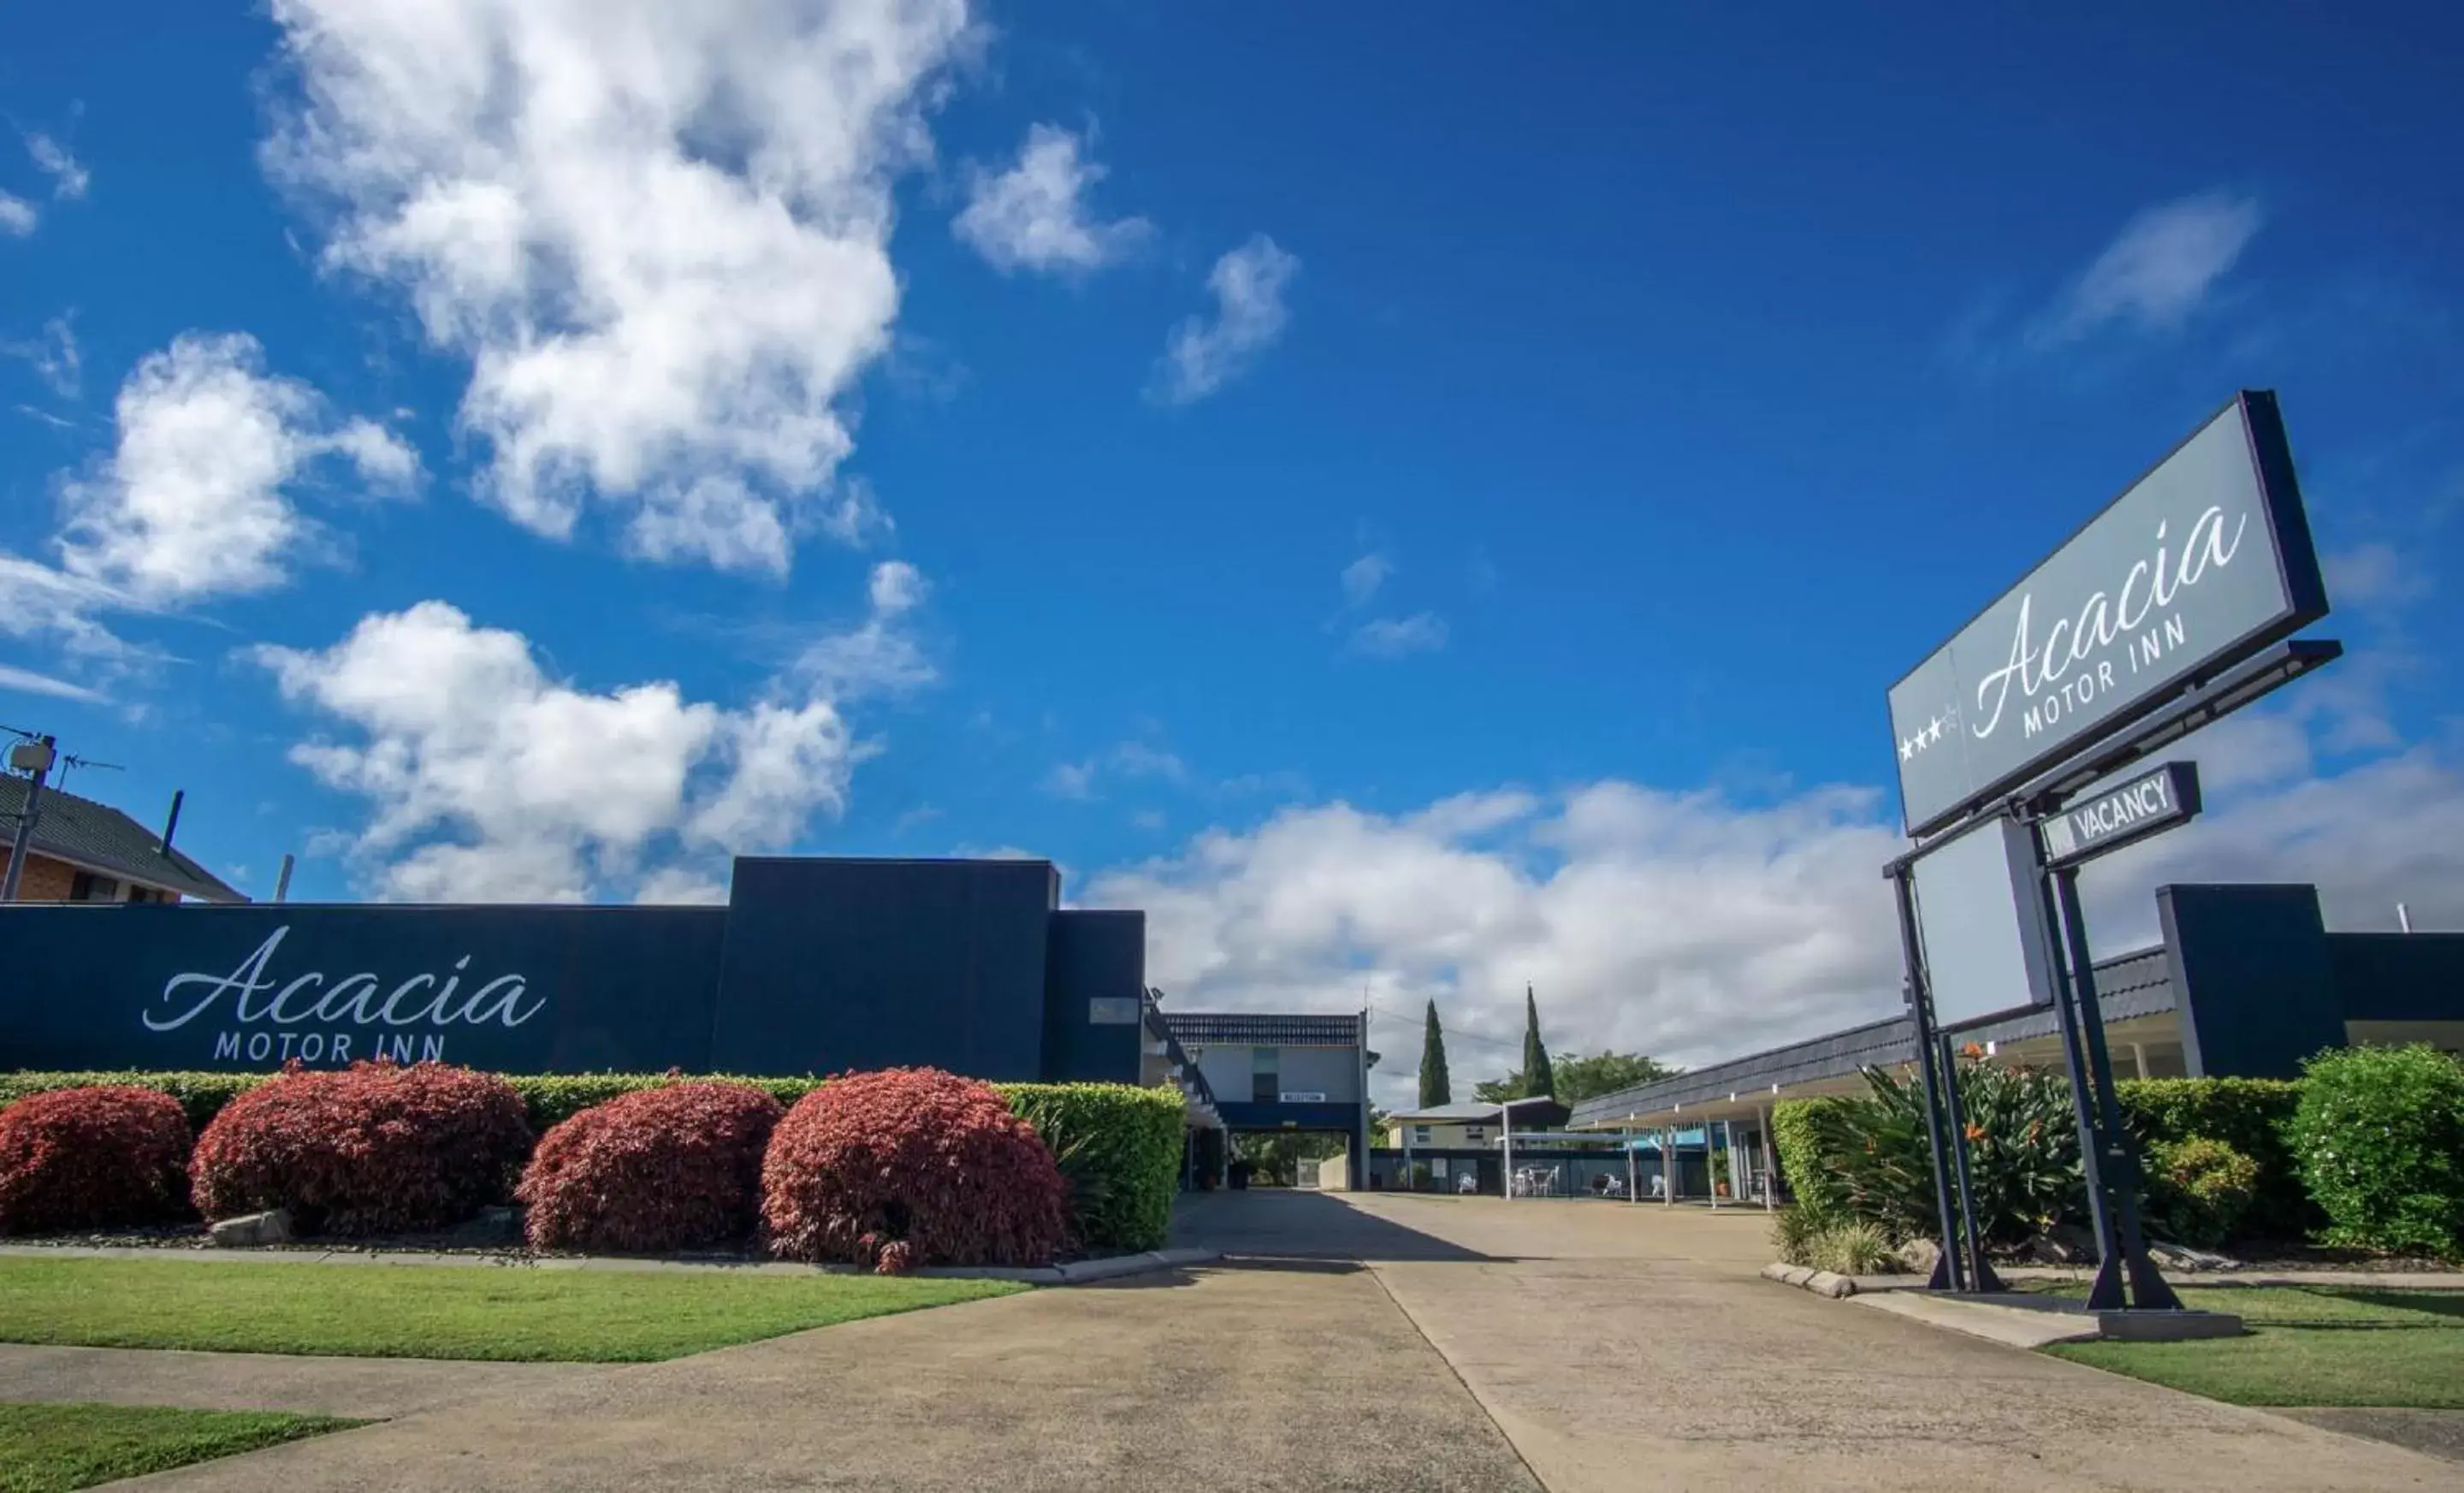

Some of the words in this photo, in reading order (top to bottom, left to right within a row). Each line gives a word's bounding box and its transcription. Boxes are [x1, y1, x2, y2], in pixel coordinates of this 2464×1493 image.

[1973, 506, 2247, 739] Acacia
[2023, 661, 2115, 739] MOTOR
[2129, 613, 2185, 674] INN
[2074, 775, 2168, 839] VACANCY
[143, 925, 547, 1031] Acacia
[214, 1031, 352, 1061] MOTOR
[374, 1034, 445, 1063] INN
